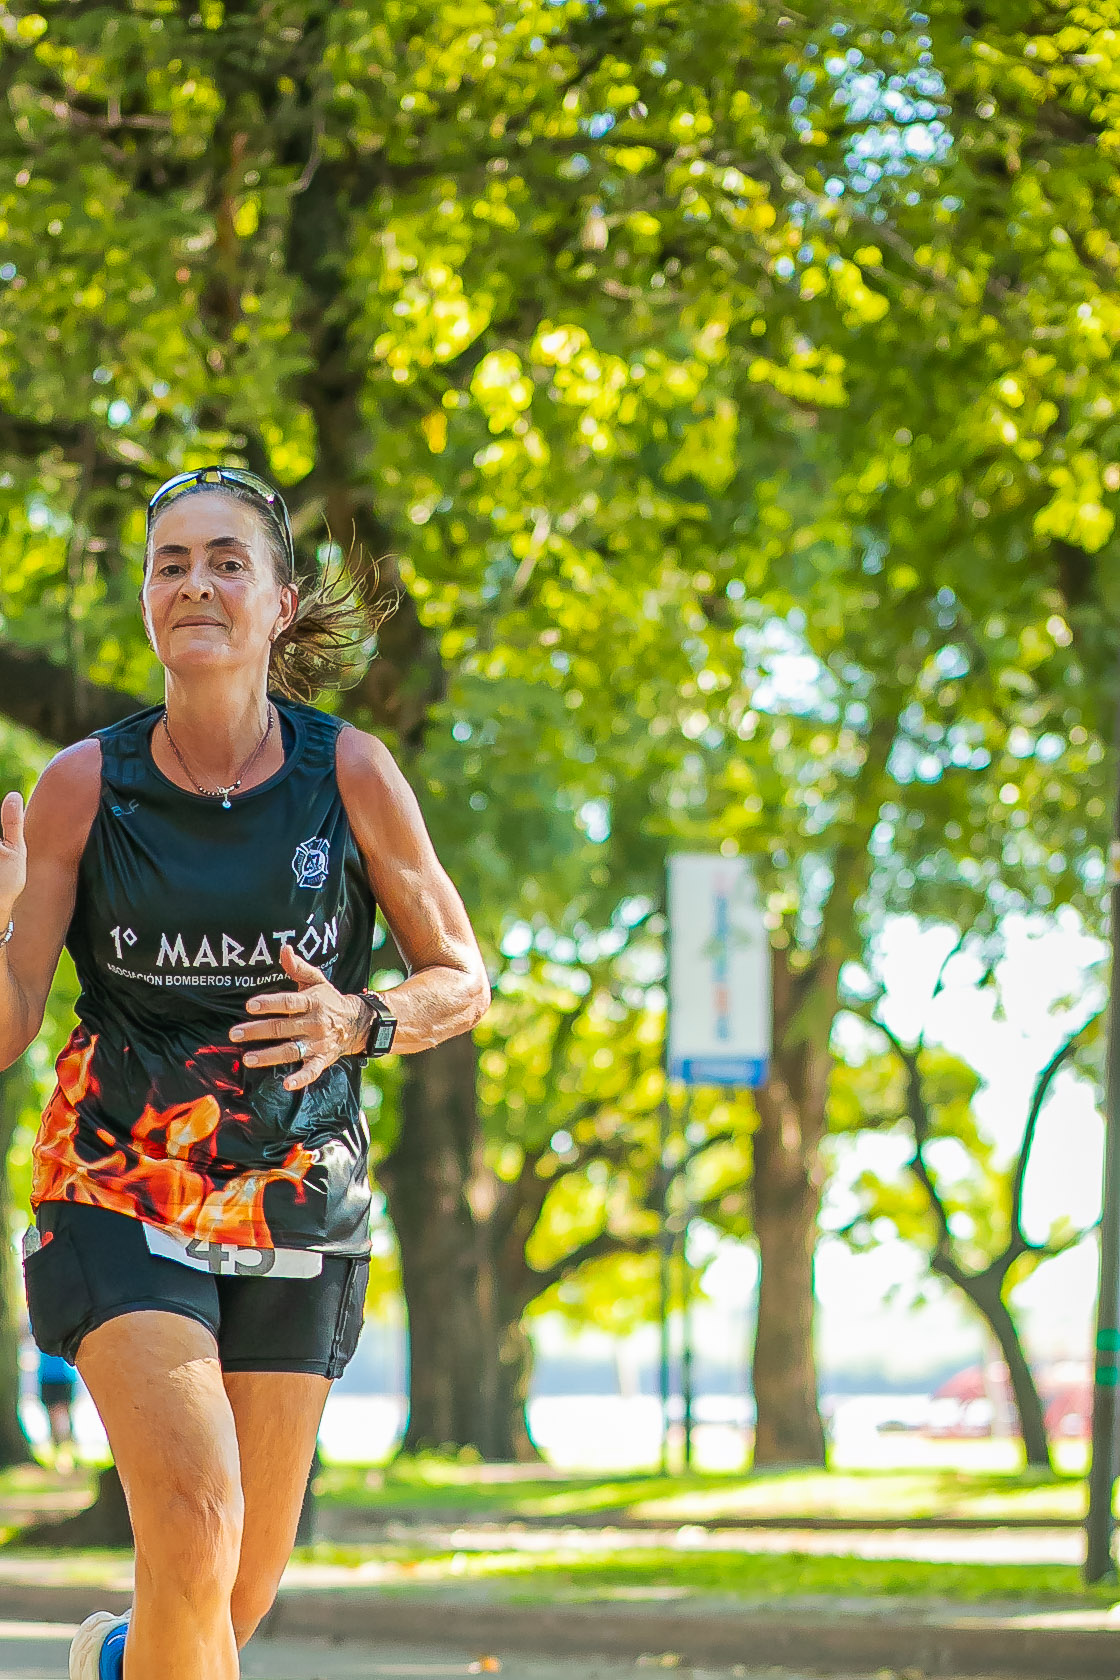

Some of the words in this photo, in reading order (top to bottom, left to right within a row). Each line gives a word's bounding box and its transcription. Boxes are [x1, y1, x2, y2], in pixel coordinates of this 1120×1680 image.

[155, 913, 338, 967] MARATÓN
[165, 976, 232, 987] BOMBEROS
[234, 972, 292, 988] VOLUNTAR
